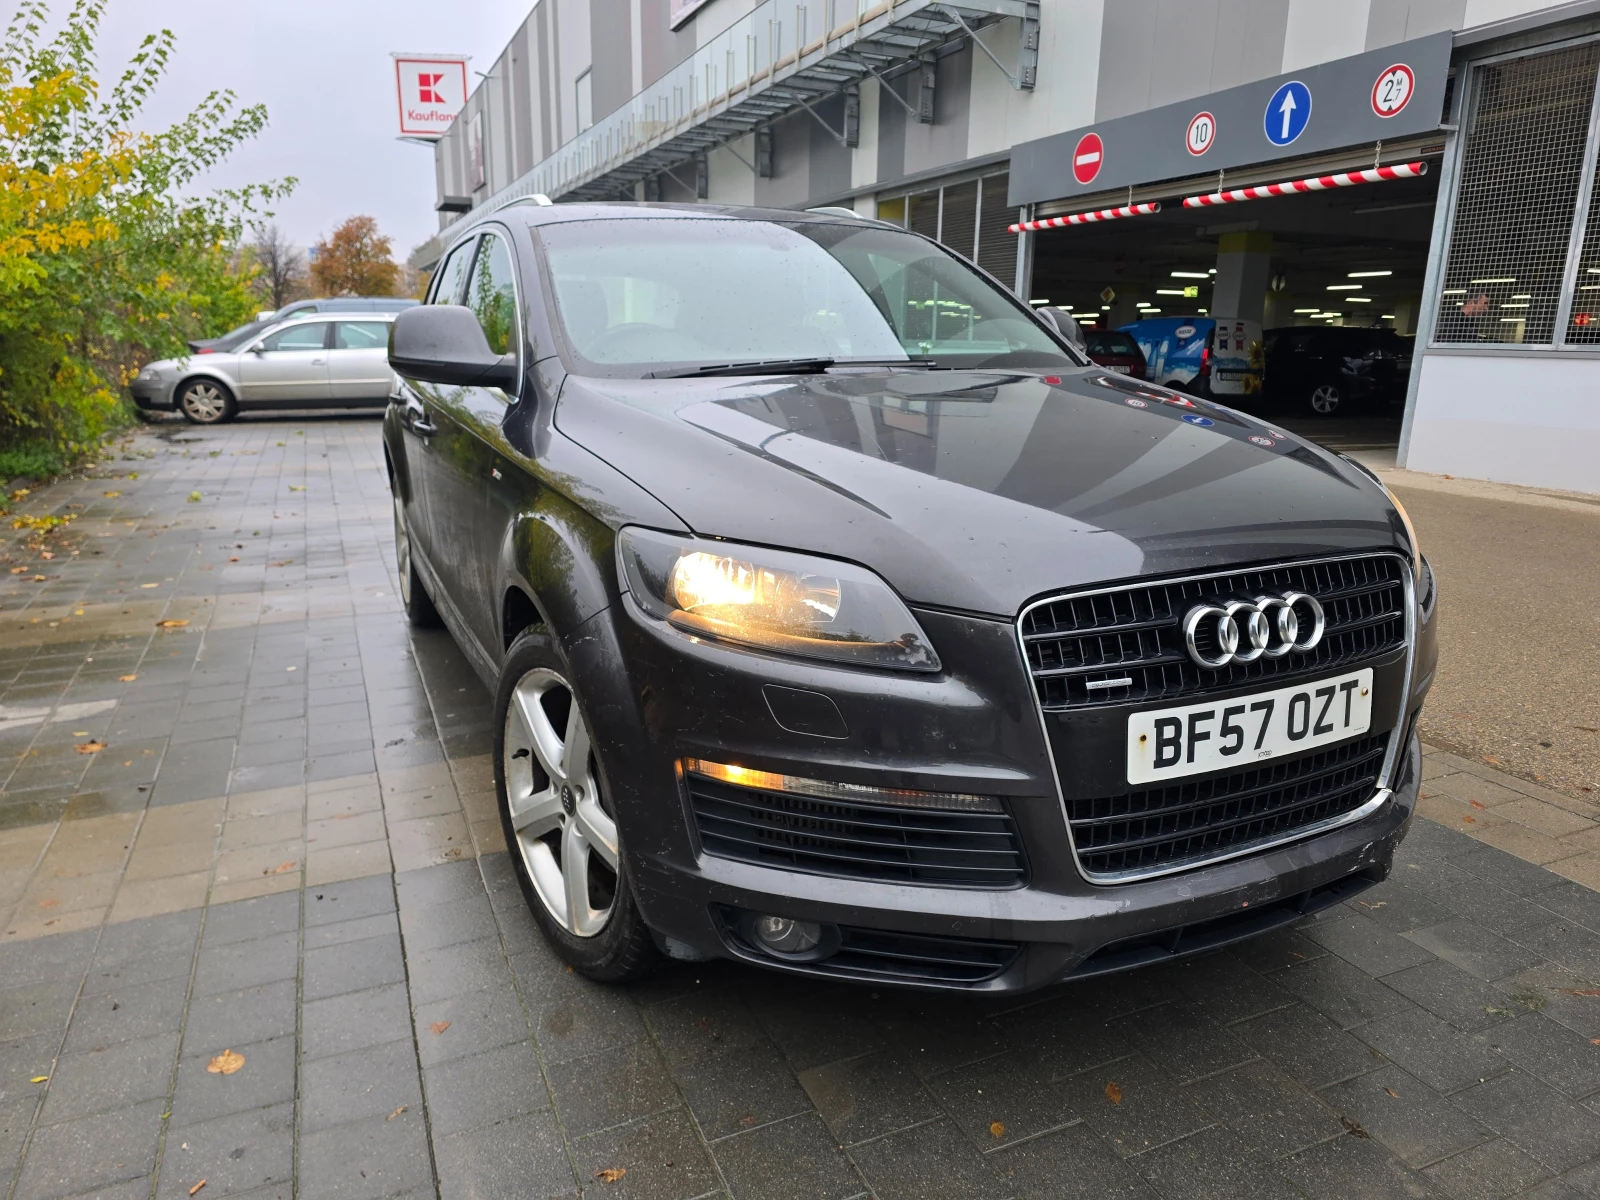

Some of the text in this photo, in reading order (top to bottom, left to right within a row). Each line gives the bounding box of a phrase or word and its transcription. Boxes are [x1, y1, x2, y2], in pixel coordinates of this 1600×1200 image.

[418, 73, 446, 103] K
[1195, 122, 1208, 144] 10
[1153, 679, 1359, 769] BF57 OZT
